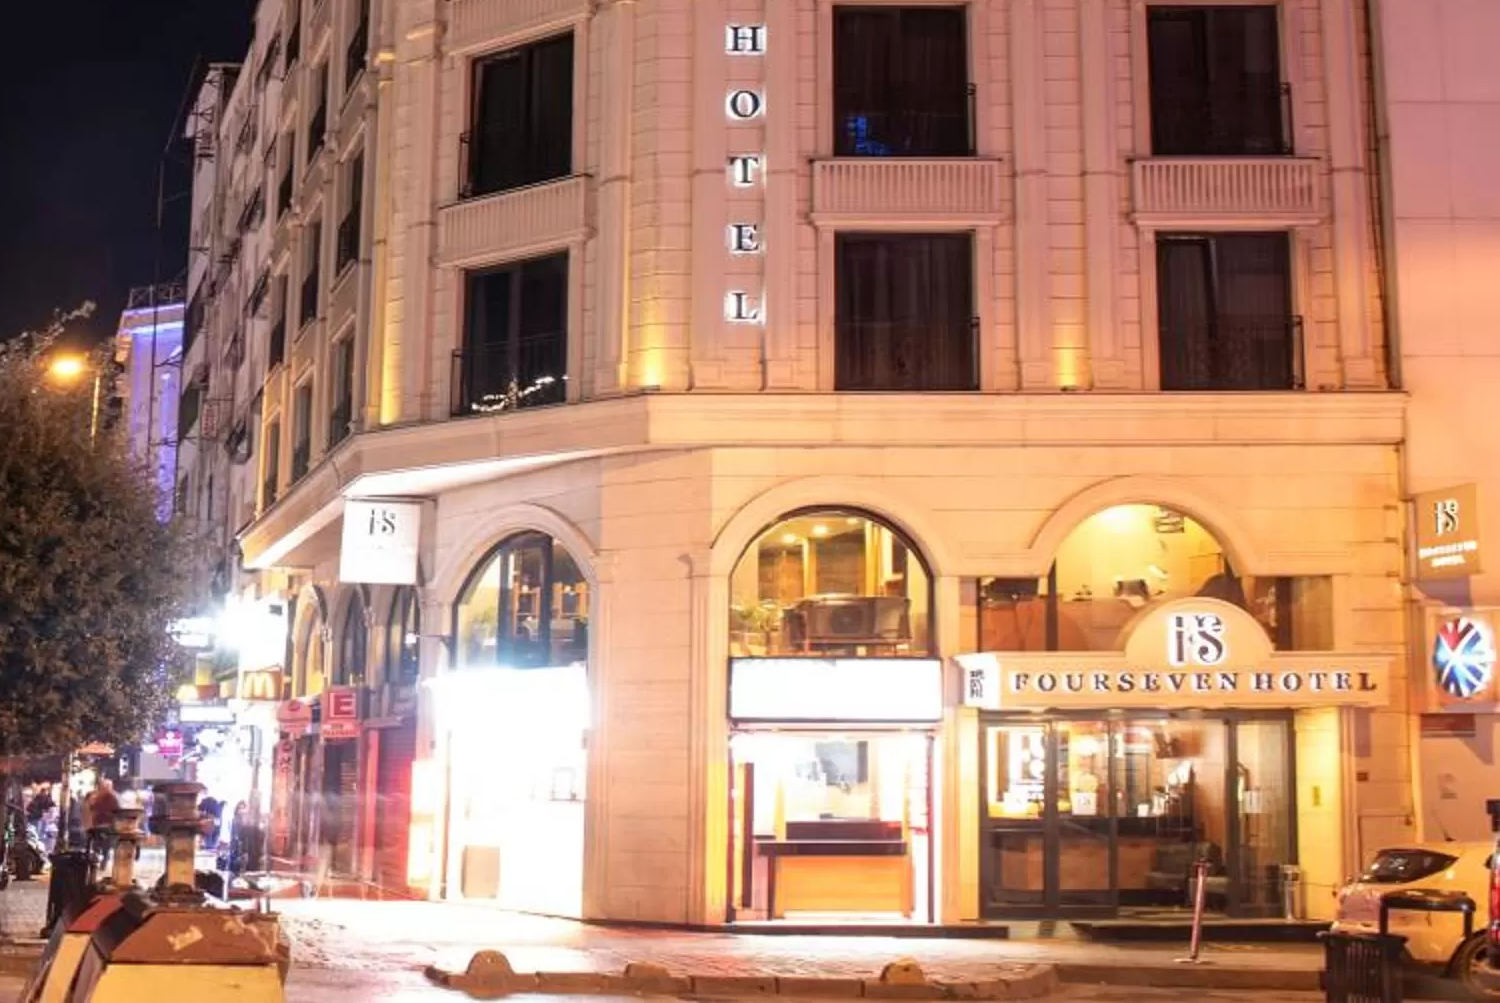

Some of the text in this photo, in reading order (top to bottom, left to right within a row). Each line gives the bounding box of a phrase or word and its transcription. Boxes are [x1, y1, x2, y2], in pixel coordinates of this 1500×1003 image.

[728, 25, 761, 321] HOTEL
[1014, 672, 1378, 692] FOURSEVEN HOTEL
